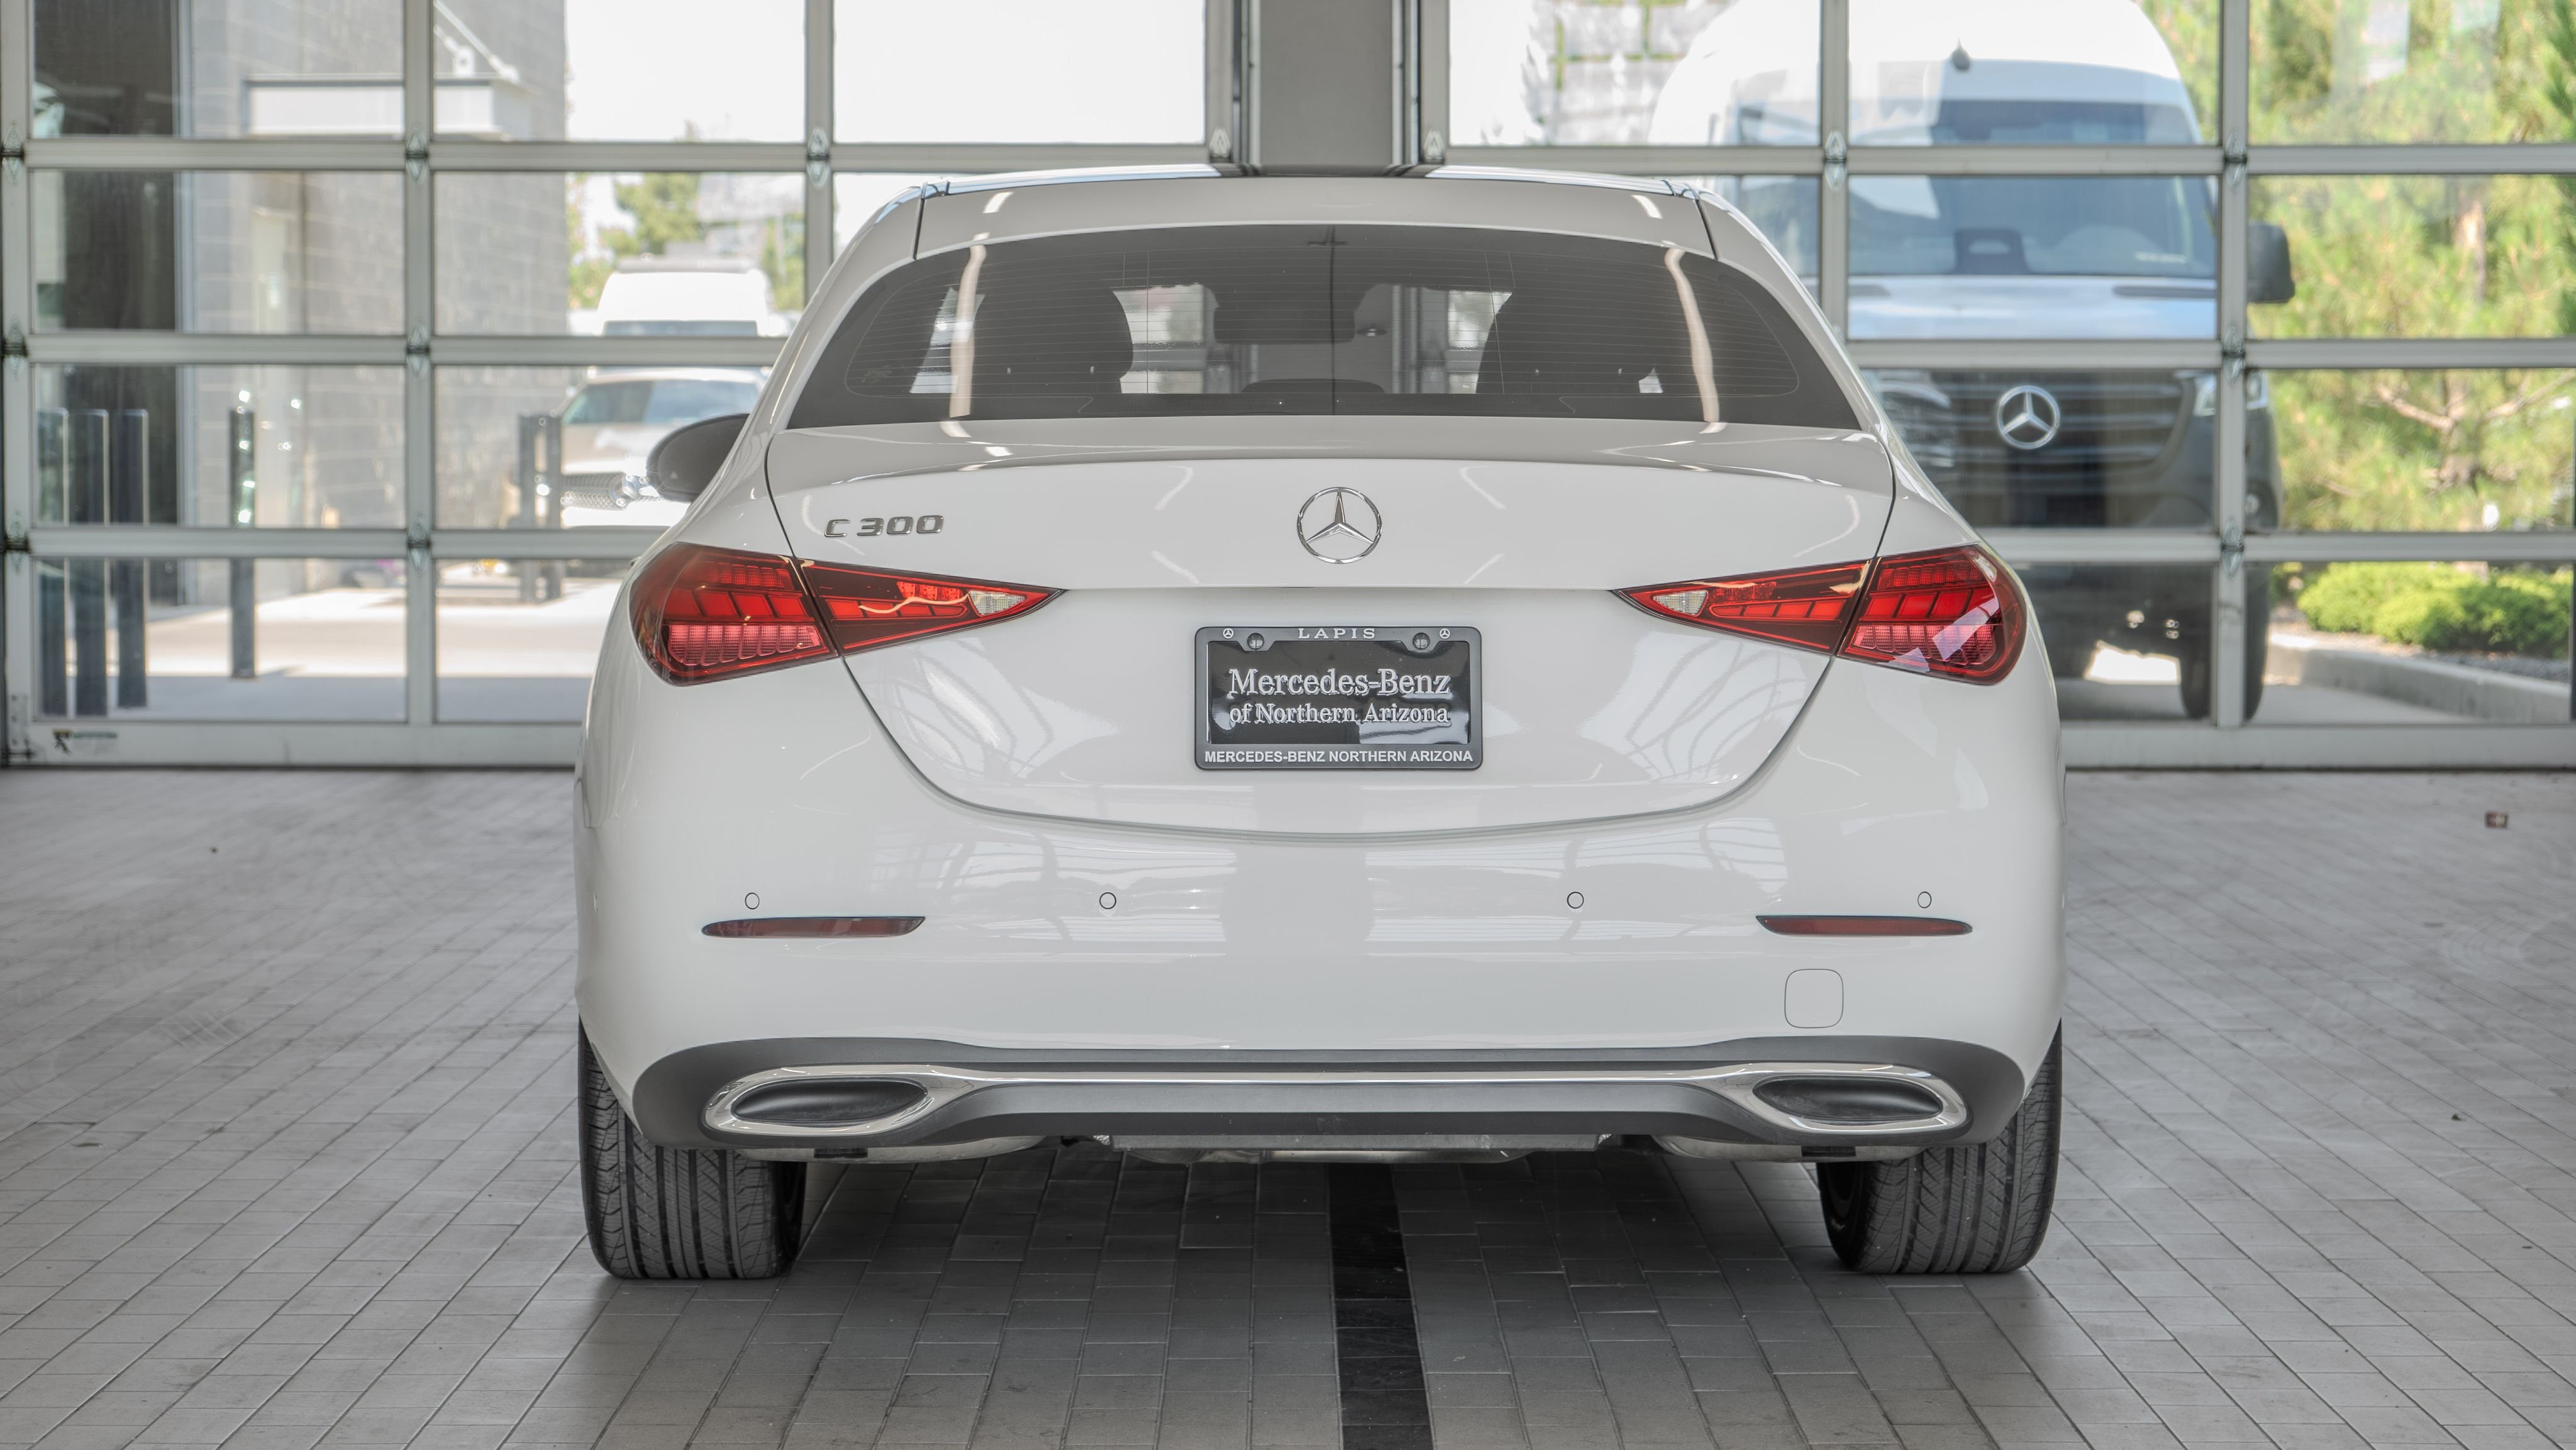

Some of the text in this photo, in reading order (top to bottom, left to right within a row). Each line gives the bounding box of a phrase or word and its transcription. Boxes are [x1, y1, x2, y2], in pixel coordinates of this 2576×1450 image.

[824, 515, 944, 537] C 300
[1298, 628, 1375, 639] LAPIS
[1229, 668, 1451, 695] Mercedes-Benz
[1230, 702, 1450, 723] of Northern Arizona
[1205, 750, 1473, 762] MERCEDES-BENZ NORTHERN ARIZONA
